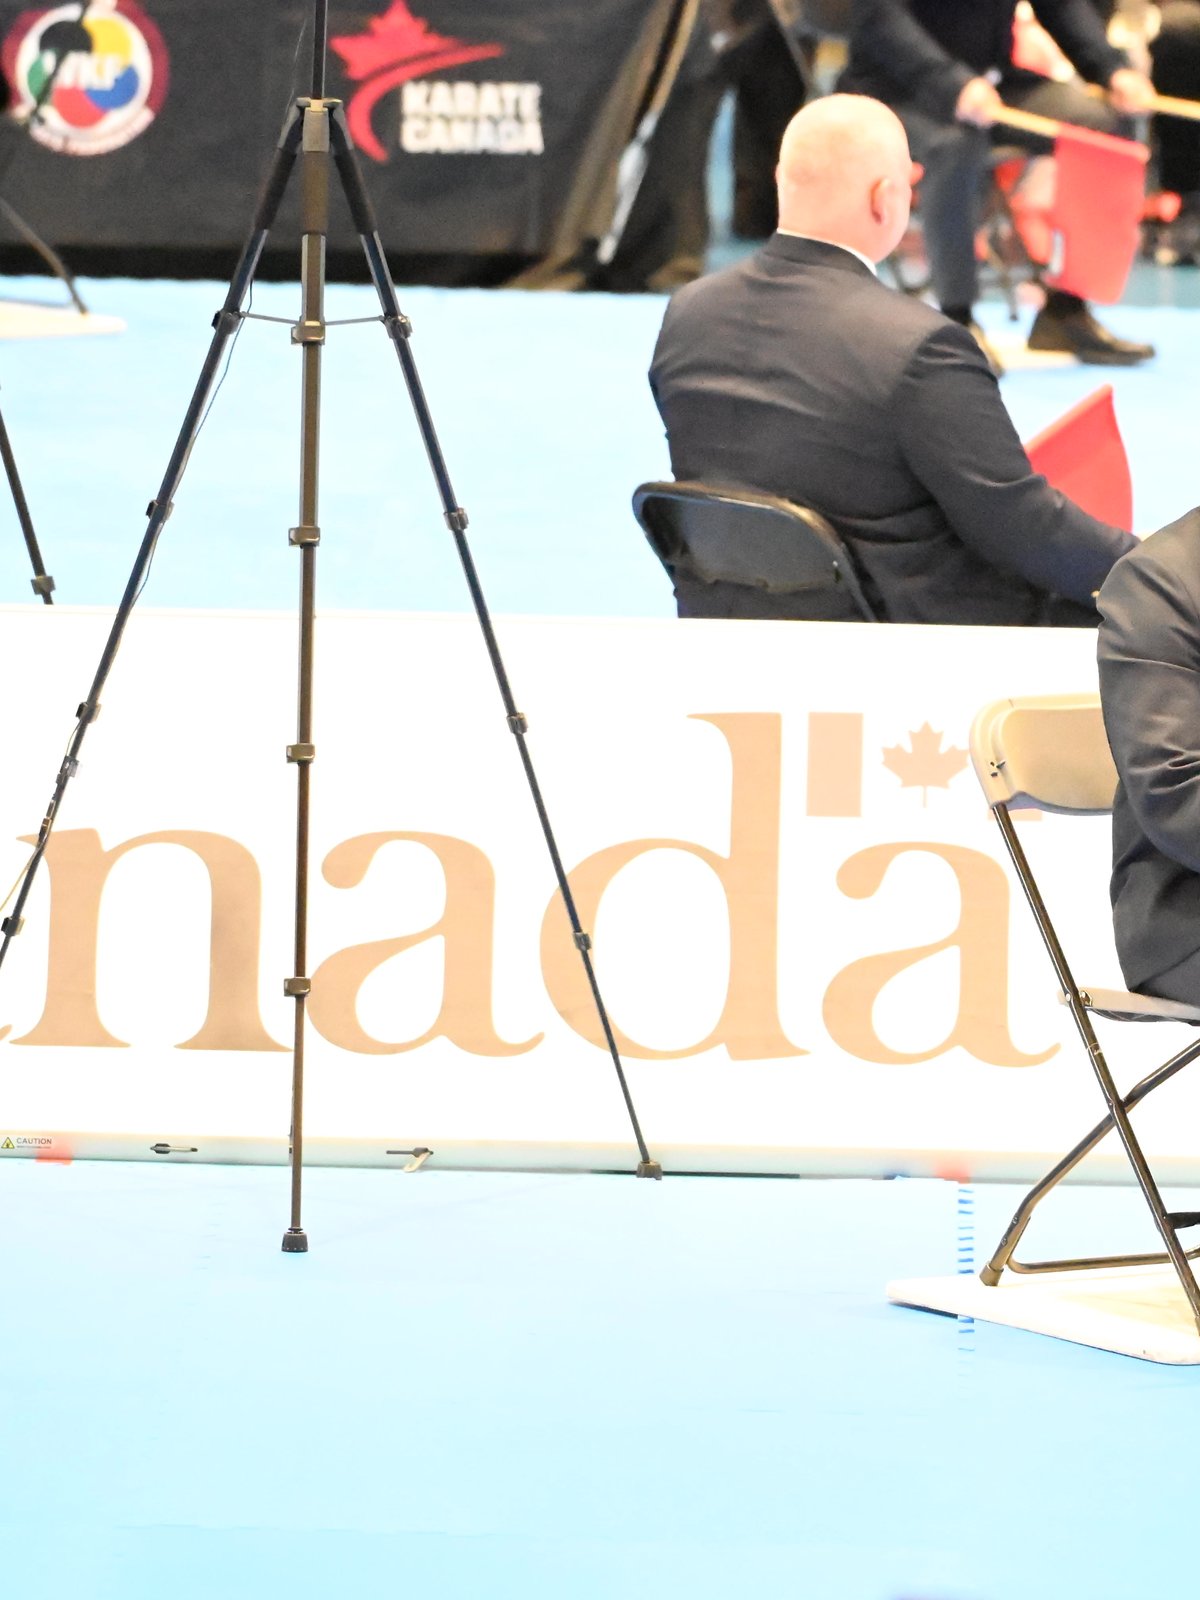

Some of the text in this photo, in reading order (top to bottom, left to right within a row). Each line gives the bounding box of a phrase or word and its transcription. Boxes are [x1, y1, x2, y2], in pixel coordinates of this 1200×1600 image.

[401, 81, 542, 119] KARATE
[400, 116, 545, 155] CANADA
[0, 712, 1061, 1067] nada
